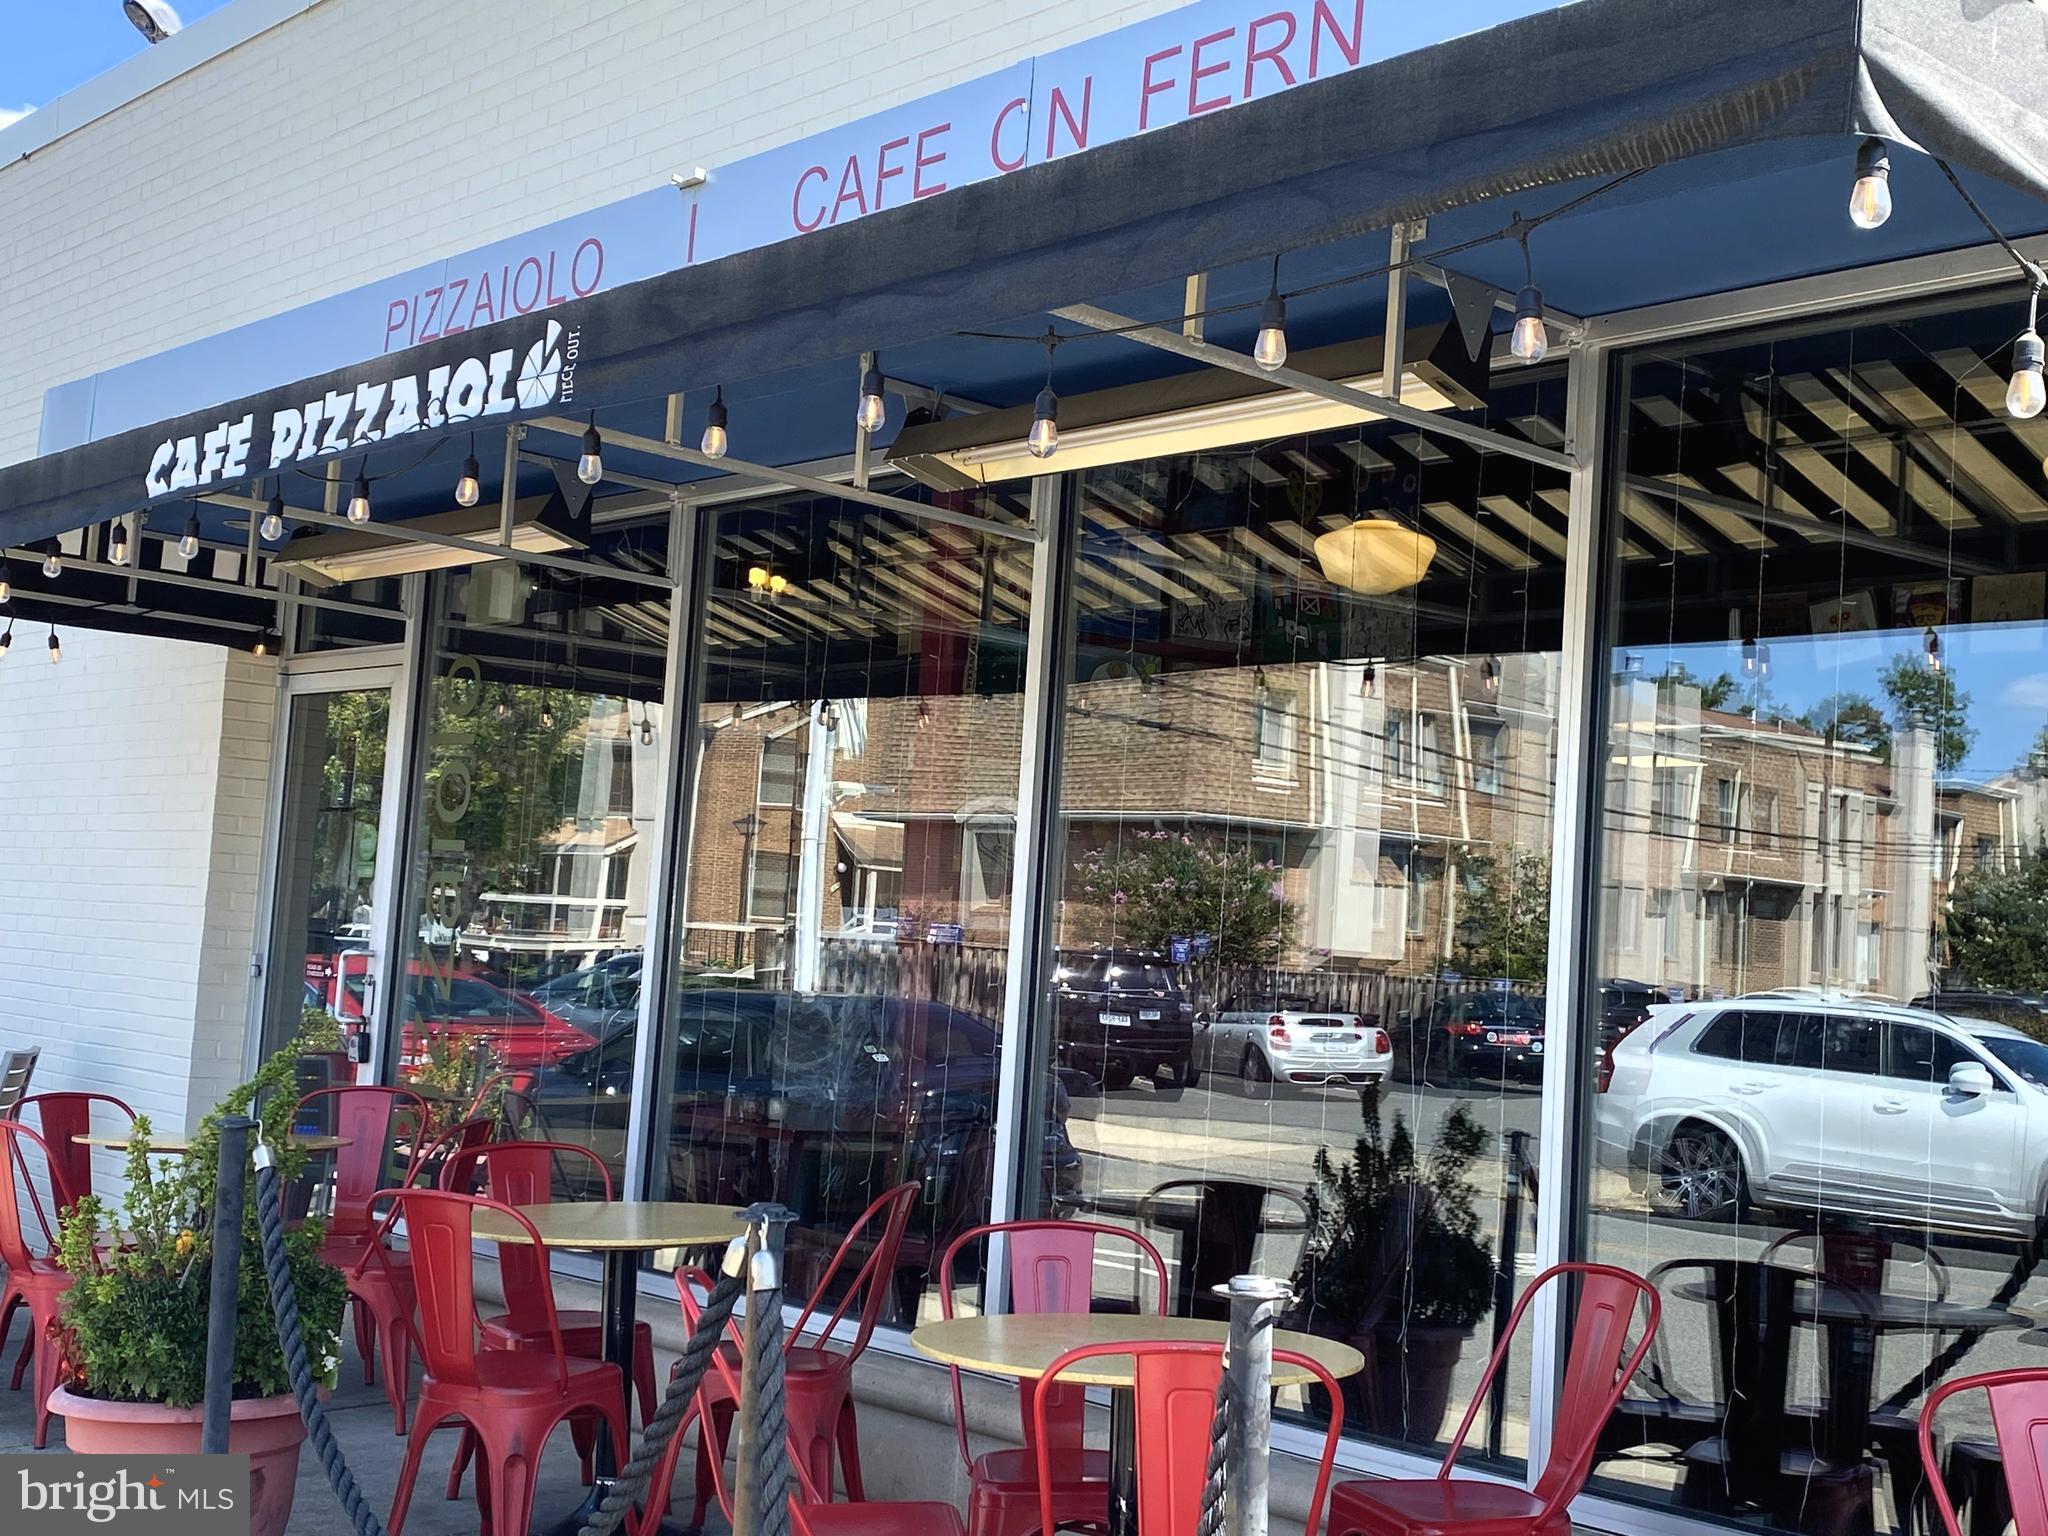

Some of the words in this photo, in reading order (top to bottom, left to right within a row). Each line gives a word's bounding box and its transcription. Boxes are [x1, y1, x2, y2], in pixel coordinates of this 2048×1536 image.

[384, 238, 604, 353] PIZZAIOLO
[793, 122, 951, 233] CAFE
[1139, 0, 1365, 131] FERN
[145, 413, 254, 499] CAFE
